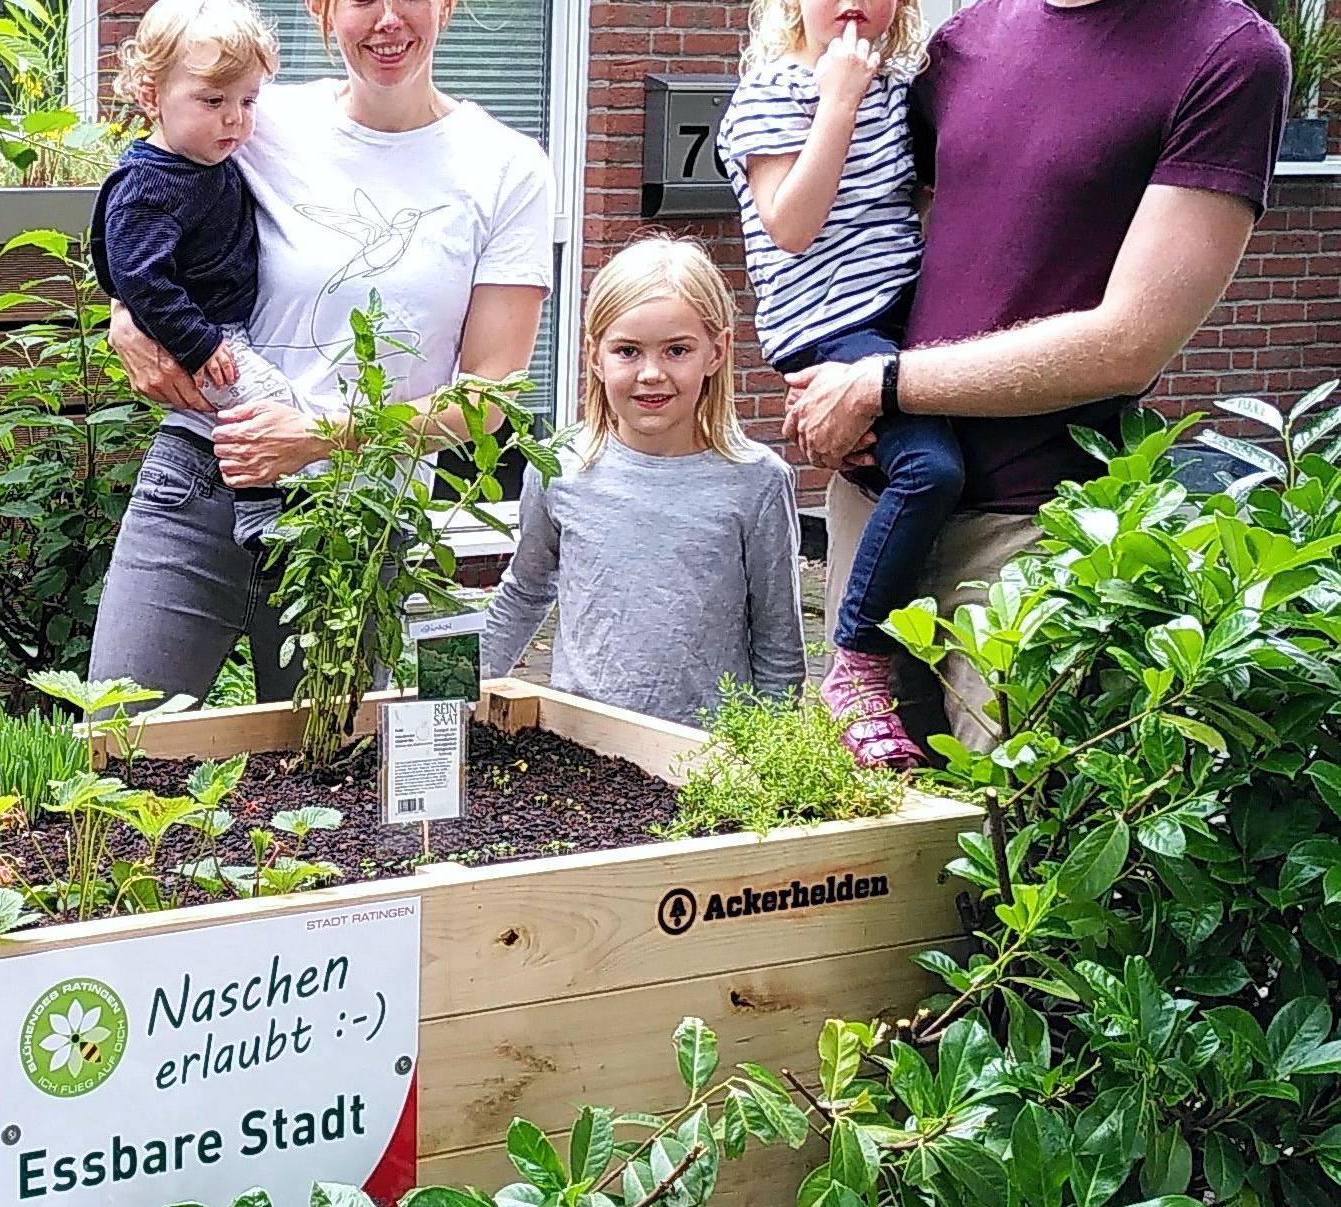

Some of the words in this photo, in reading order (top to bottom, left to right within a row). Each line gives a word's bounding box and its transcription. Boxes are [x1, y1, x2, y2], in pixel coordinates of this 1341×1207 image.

[679, 125, 730, 179] 7
[433, 713, 458, 726] SAAT
[434, 702, 458, 715] REIN
[306, 915, 349, 931] STADT
[351, 905, 415, 924] RATINGEN
[703, 873, 889, 921] Ackerhelden
[62, 982, 121, 1015] RATINGEN
[148, 955, 349, 1037] Naschen
[38, 1076, 59, 1092] ICH
[60, 1078, 94, 1094] FLIEG
[97, 1055, 116, 1081] AUF
[114, 1019, 126, 1053] DICH
[155, 1016, 312, 1090] erlaubt
[19, 1128, 223, 1200] Essbare
[240, 1095, 366, 1156] Stadt
